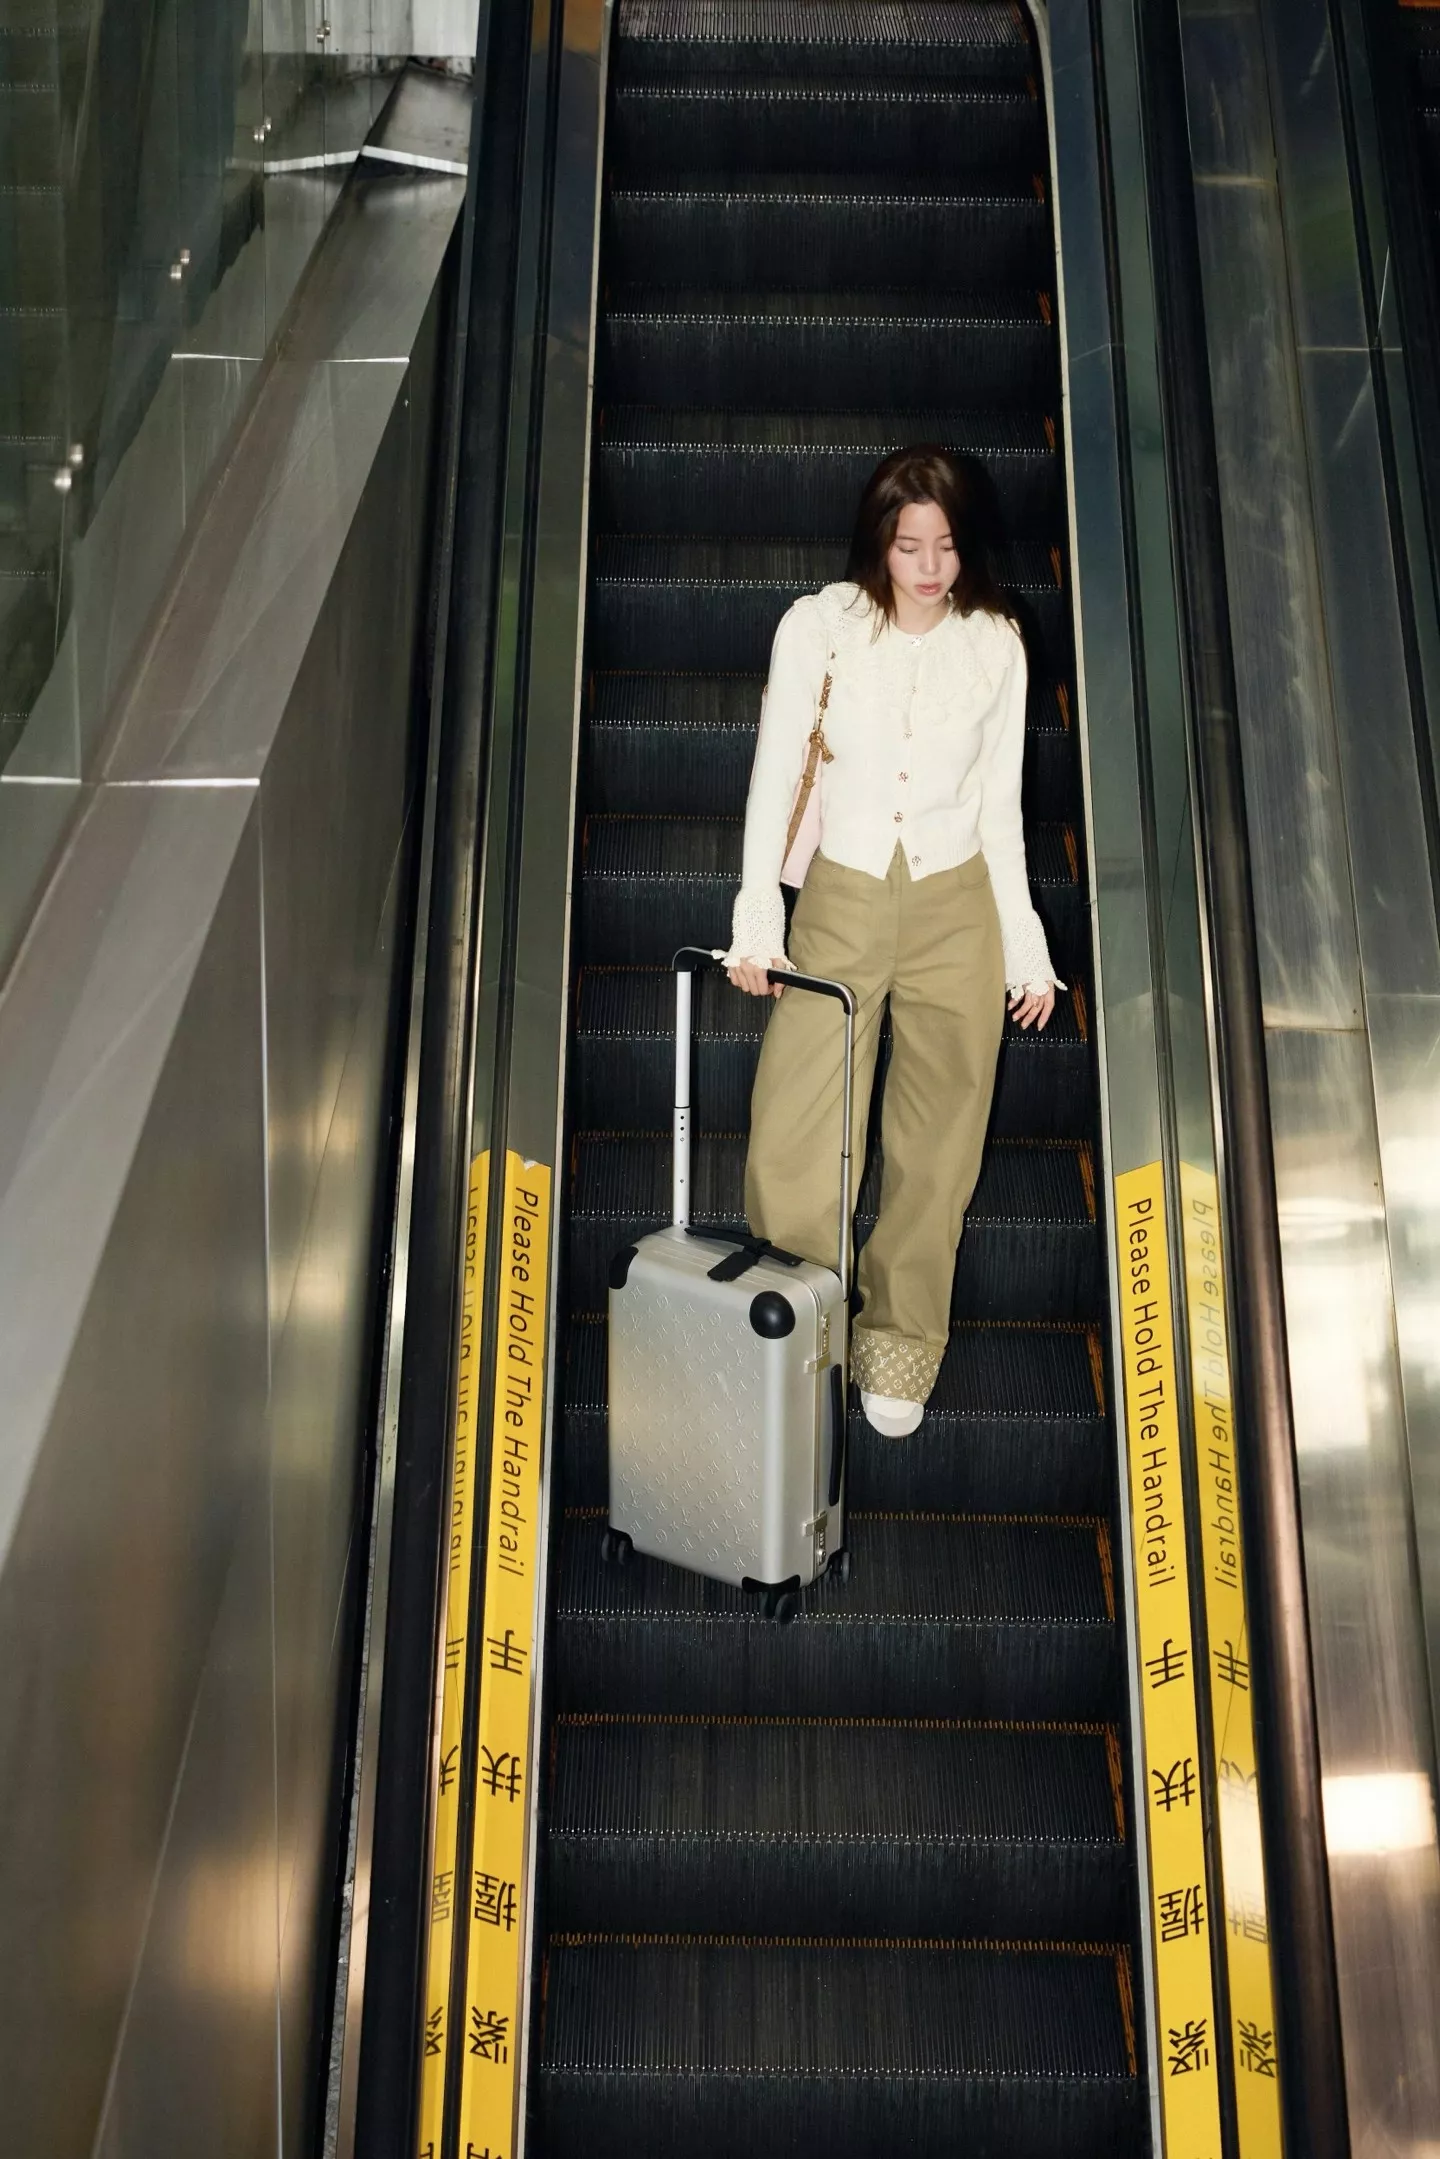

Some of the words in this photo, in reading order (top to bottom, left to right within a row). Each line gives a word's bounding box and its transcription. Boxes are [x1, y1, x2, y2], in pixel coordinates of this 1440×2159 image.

[511, 1186, 539, 1282] Please
[1127, 1197, 1155, 1295] Please
[507, 1290, 535, 1366] Hold
[1133, 1300, 1163, 1376] Hold
[504, 1374, 532, 1428] The
[1138, 1379, 1166, 1441] The
[498, 1435, 529, 1577] Handrail
[1141, 1446, 1177, 1588] Handrail
